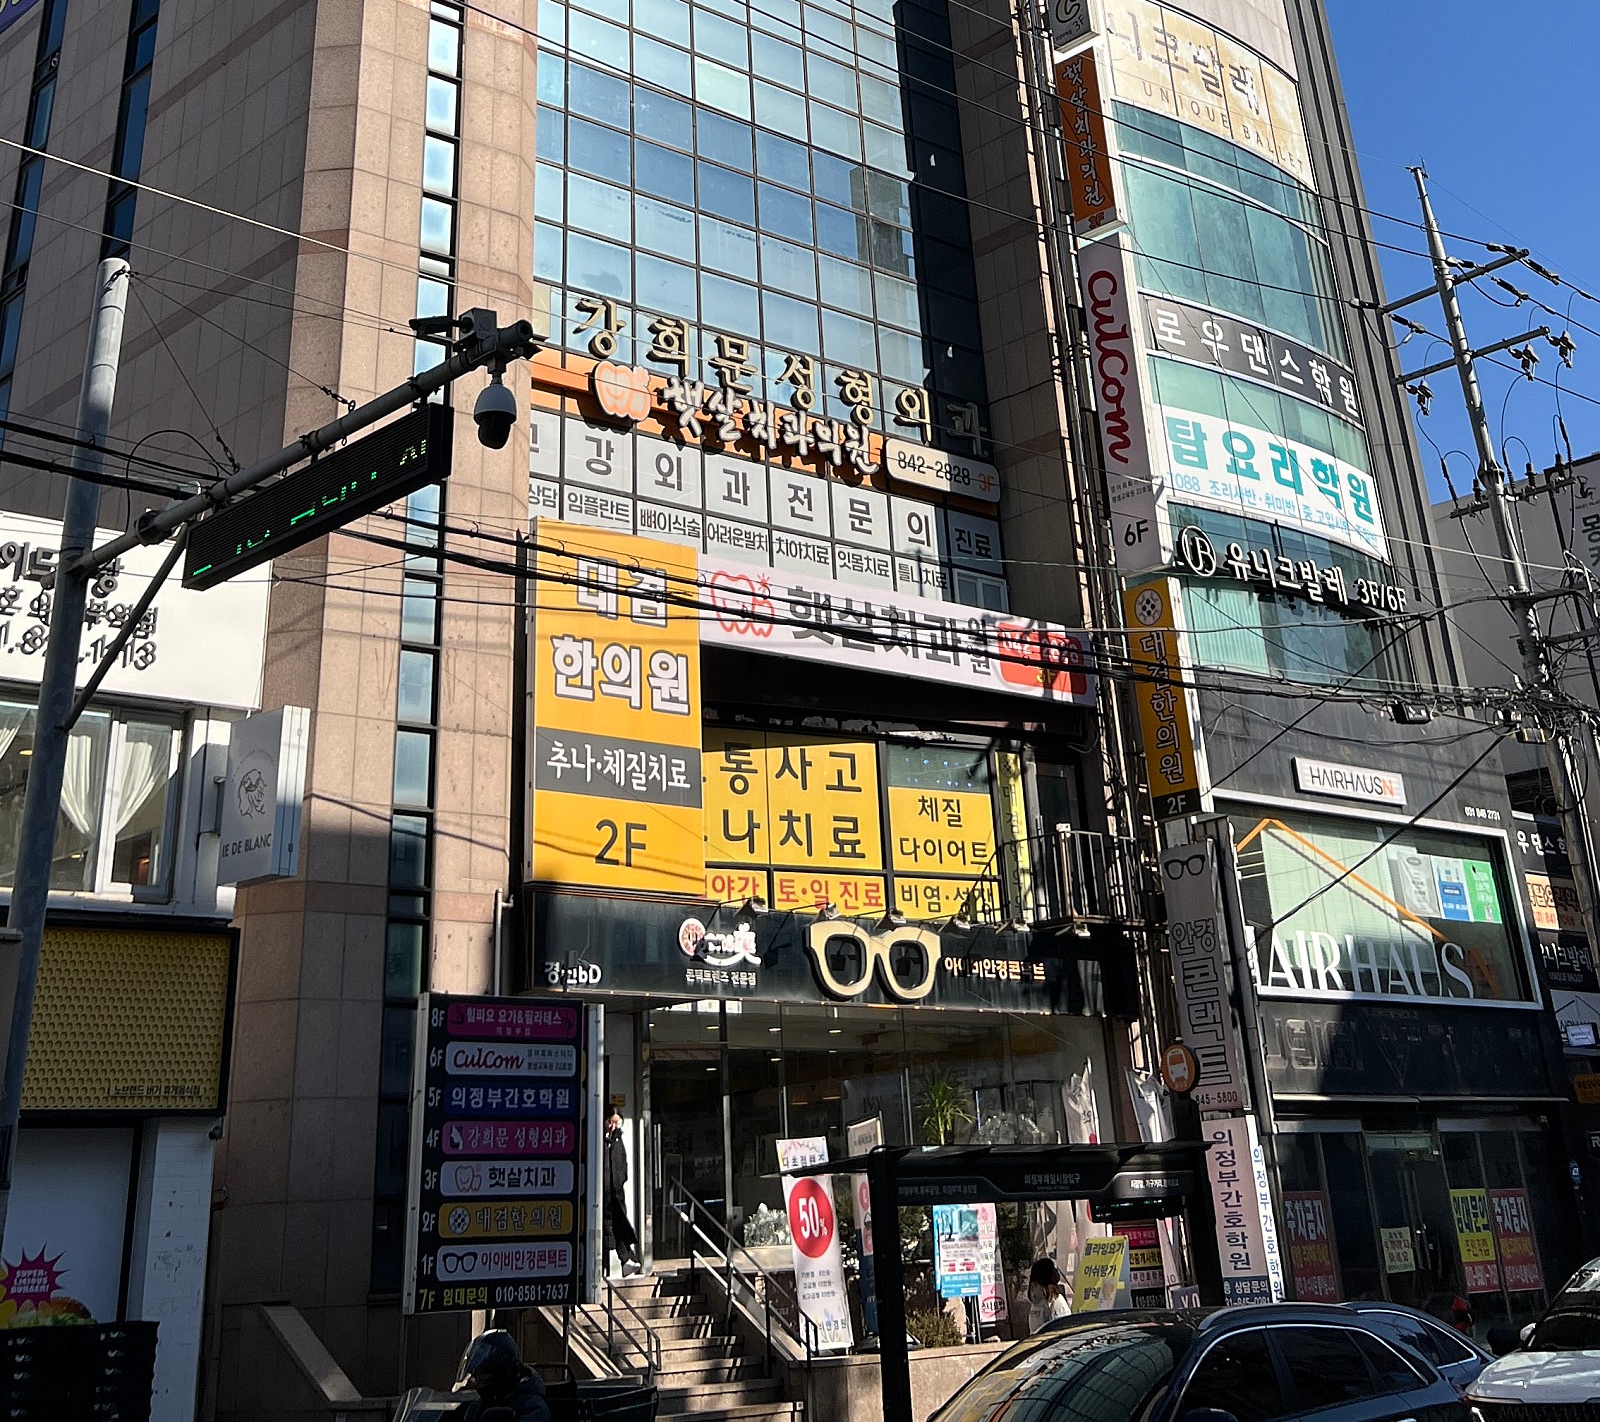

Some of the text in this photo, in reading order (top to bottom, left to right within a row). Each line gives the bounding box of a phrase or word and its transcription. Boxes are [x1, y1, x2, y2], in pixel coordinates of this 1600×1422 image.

[1142, 81, 1304, 170] UNIQUE BALLET
[1087, 269, 1132, 465] CulCom
[898, 450, 970, 484] 842-2828
[568, 492, 631, 523] 임플란트
[640, 509, 701, 539] 뼈이식술
[707, 522, 768, 553] 어려운발치
[1124, 519, 1149, 547] 6F
[775, 537, 830, 564] 치아치료
[955, 527, 992, 560] 진료
[838, 551, 890, 578] 잇몸치료
[1227, 542, 1349, 606] 유니크발레
[550, 634, 691, 716] 한의원
[703, 740, 863, 794] 통사고
[918, 795, 963, 828] 체질
[1167, 795, 1187, 816] 2F
[231, 840, 243, 855] DE
[245, 833, 272, 852] BLANC
[595, 818, 647, 868] 2F
[703, 808, 866, 859] 나치료
[899, 837, 988, 866] 다이어트
[704, 875, 761, 906] 야간
[839, 881, 884, 910] 진료
[1172, 917, 1217, 957] 안경
[431, 1007, 445, 1028] 8F
[1181, 955, 1232, 1087] 콘택트
[430, 1046, 443, 1067] 6F
[453, 1047, 525, 1070] CulCom
[428, 1087, 441, 1108] 5F
[451, 1086, 570, 1109] 의정부간호학원
[425, 1129, 439, 1149] 4F
[467, 1126, 568, 1148] 강희문 성형외과
[424, 1171, 438, 1191] 3F
[488, 1166, 557, 1188] 햇살치과
[1213, 1129, 1252, 1271] 의정부간호학원
[422, 1212, 436, 1233] 2F
[475, 1205, 562, 1232] 대겸한의원
[798, 1195, 828, 1240] 50%
[421, 1255, 434, 1276] 1F
[481, 1249, 568, 1272] 아이비안경콘택트
[419, 1288, 435, 1311] 7F
[443, 1287, 488, 1306] 임대문의
